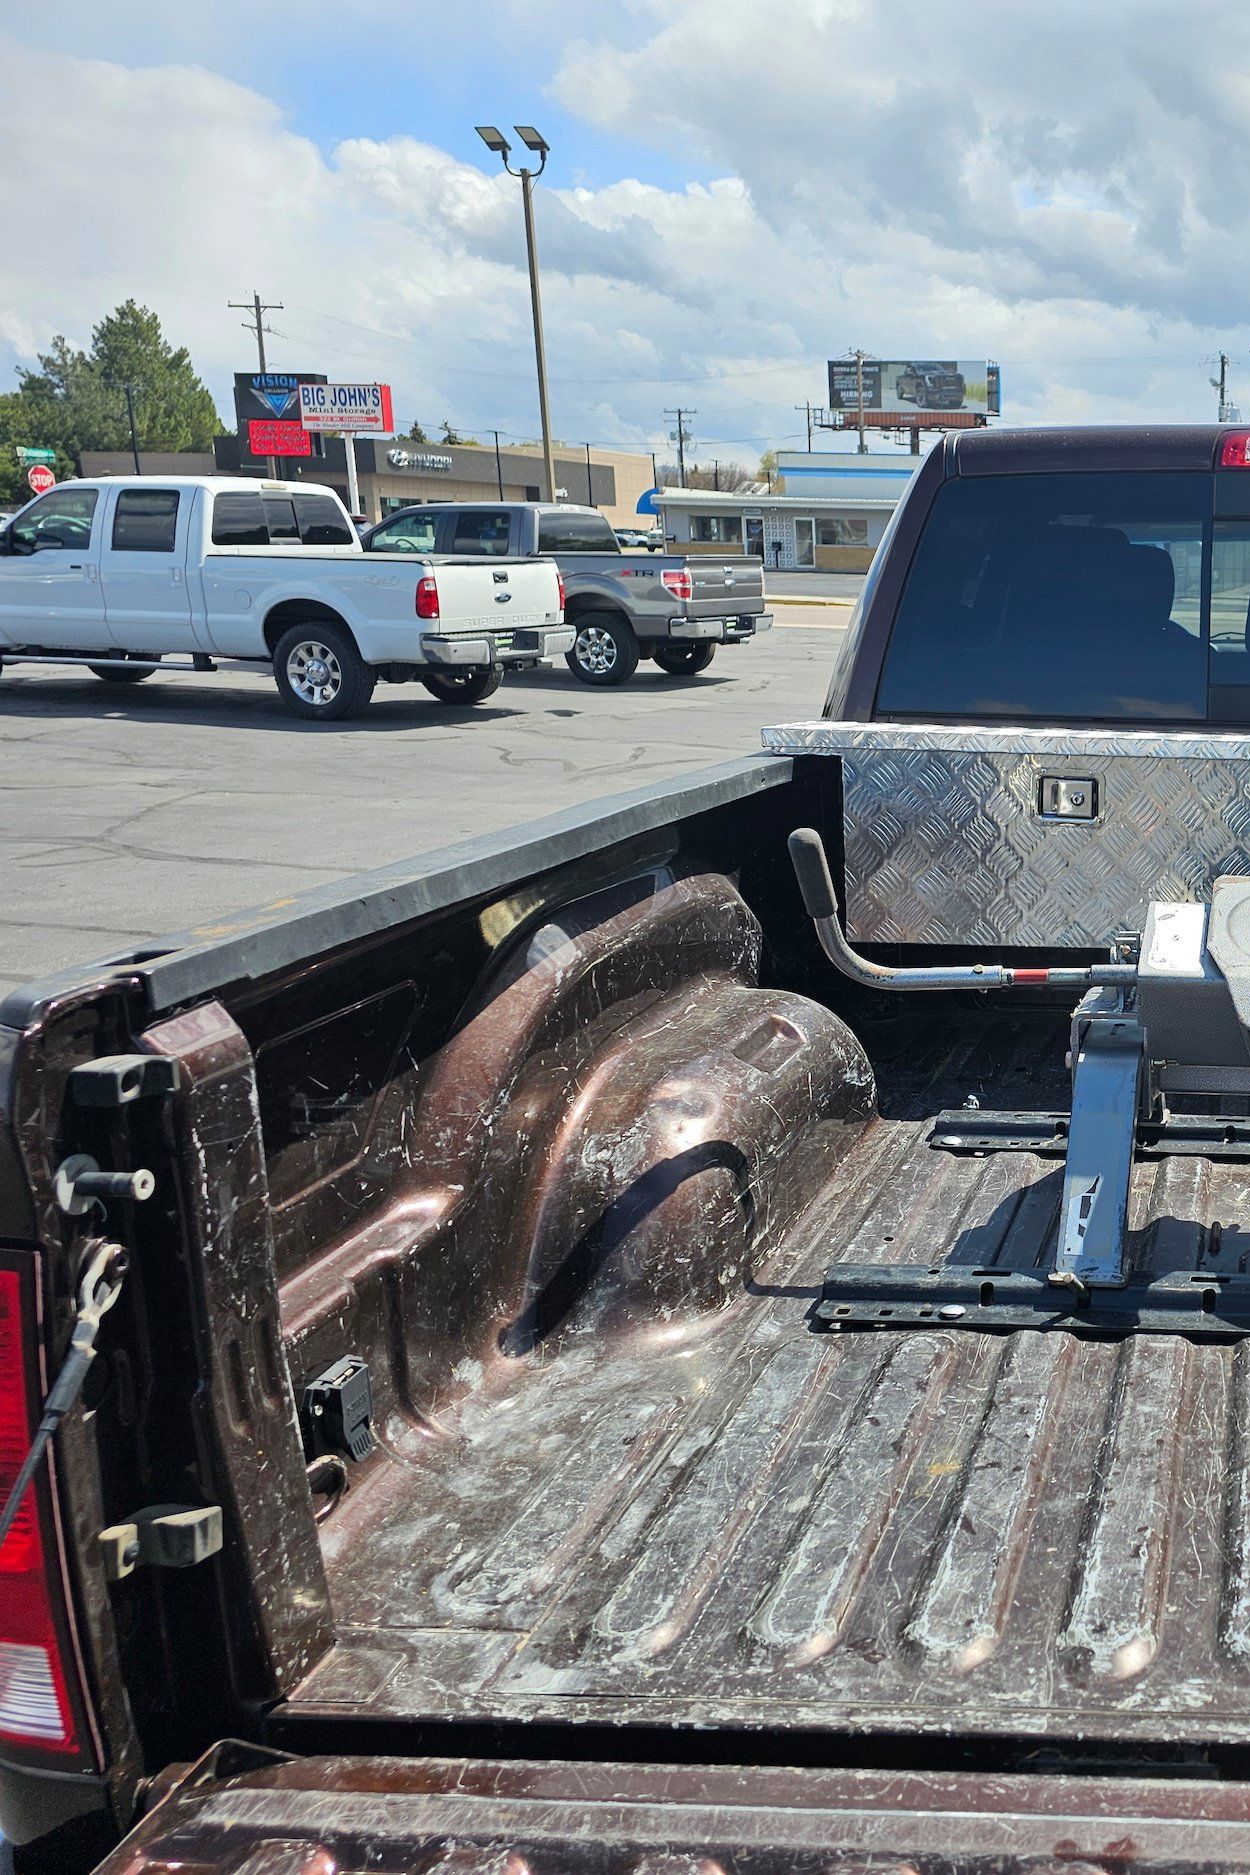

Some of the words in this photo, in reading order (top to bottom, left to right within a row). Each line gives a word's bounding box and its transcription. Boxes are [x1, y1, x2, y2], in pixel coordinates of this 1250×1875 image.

[252, 375, 298, 390] VISION
[301, 387, 326, 406] BIG
[330, 387, 380, 407] JOHN'S
[337, 407, 376, 415] Storage
[31, 474, 53, 487] STOP
[620, 569, 654, 577] XTR
[463, 616, 505, 628] SUPER
[511, 614, 546, 625] DUTY
